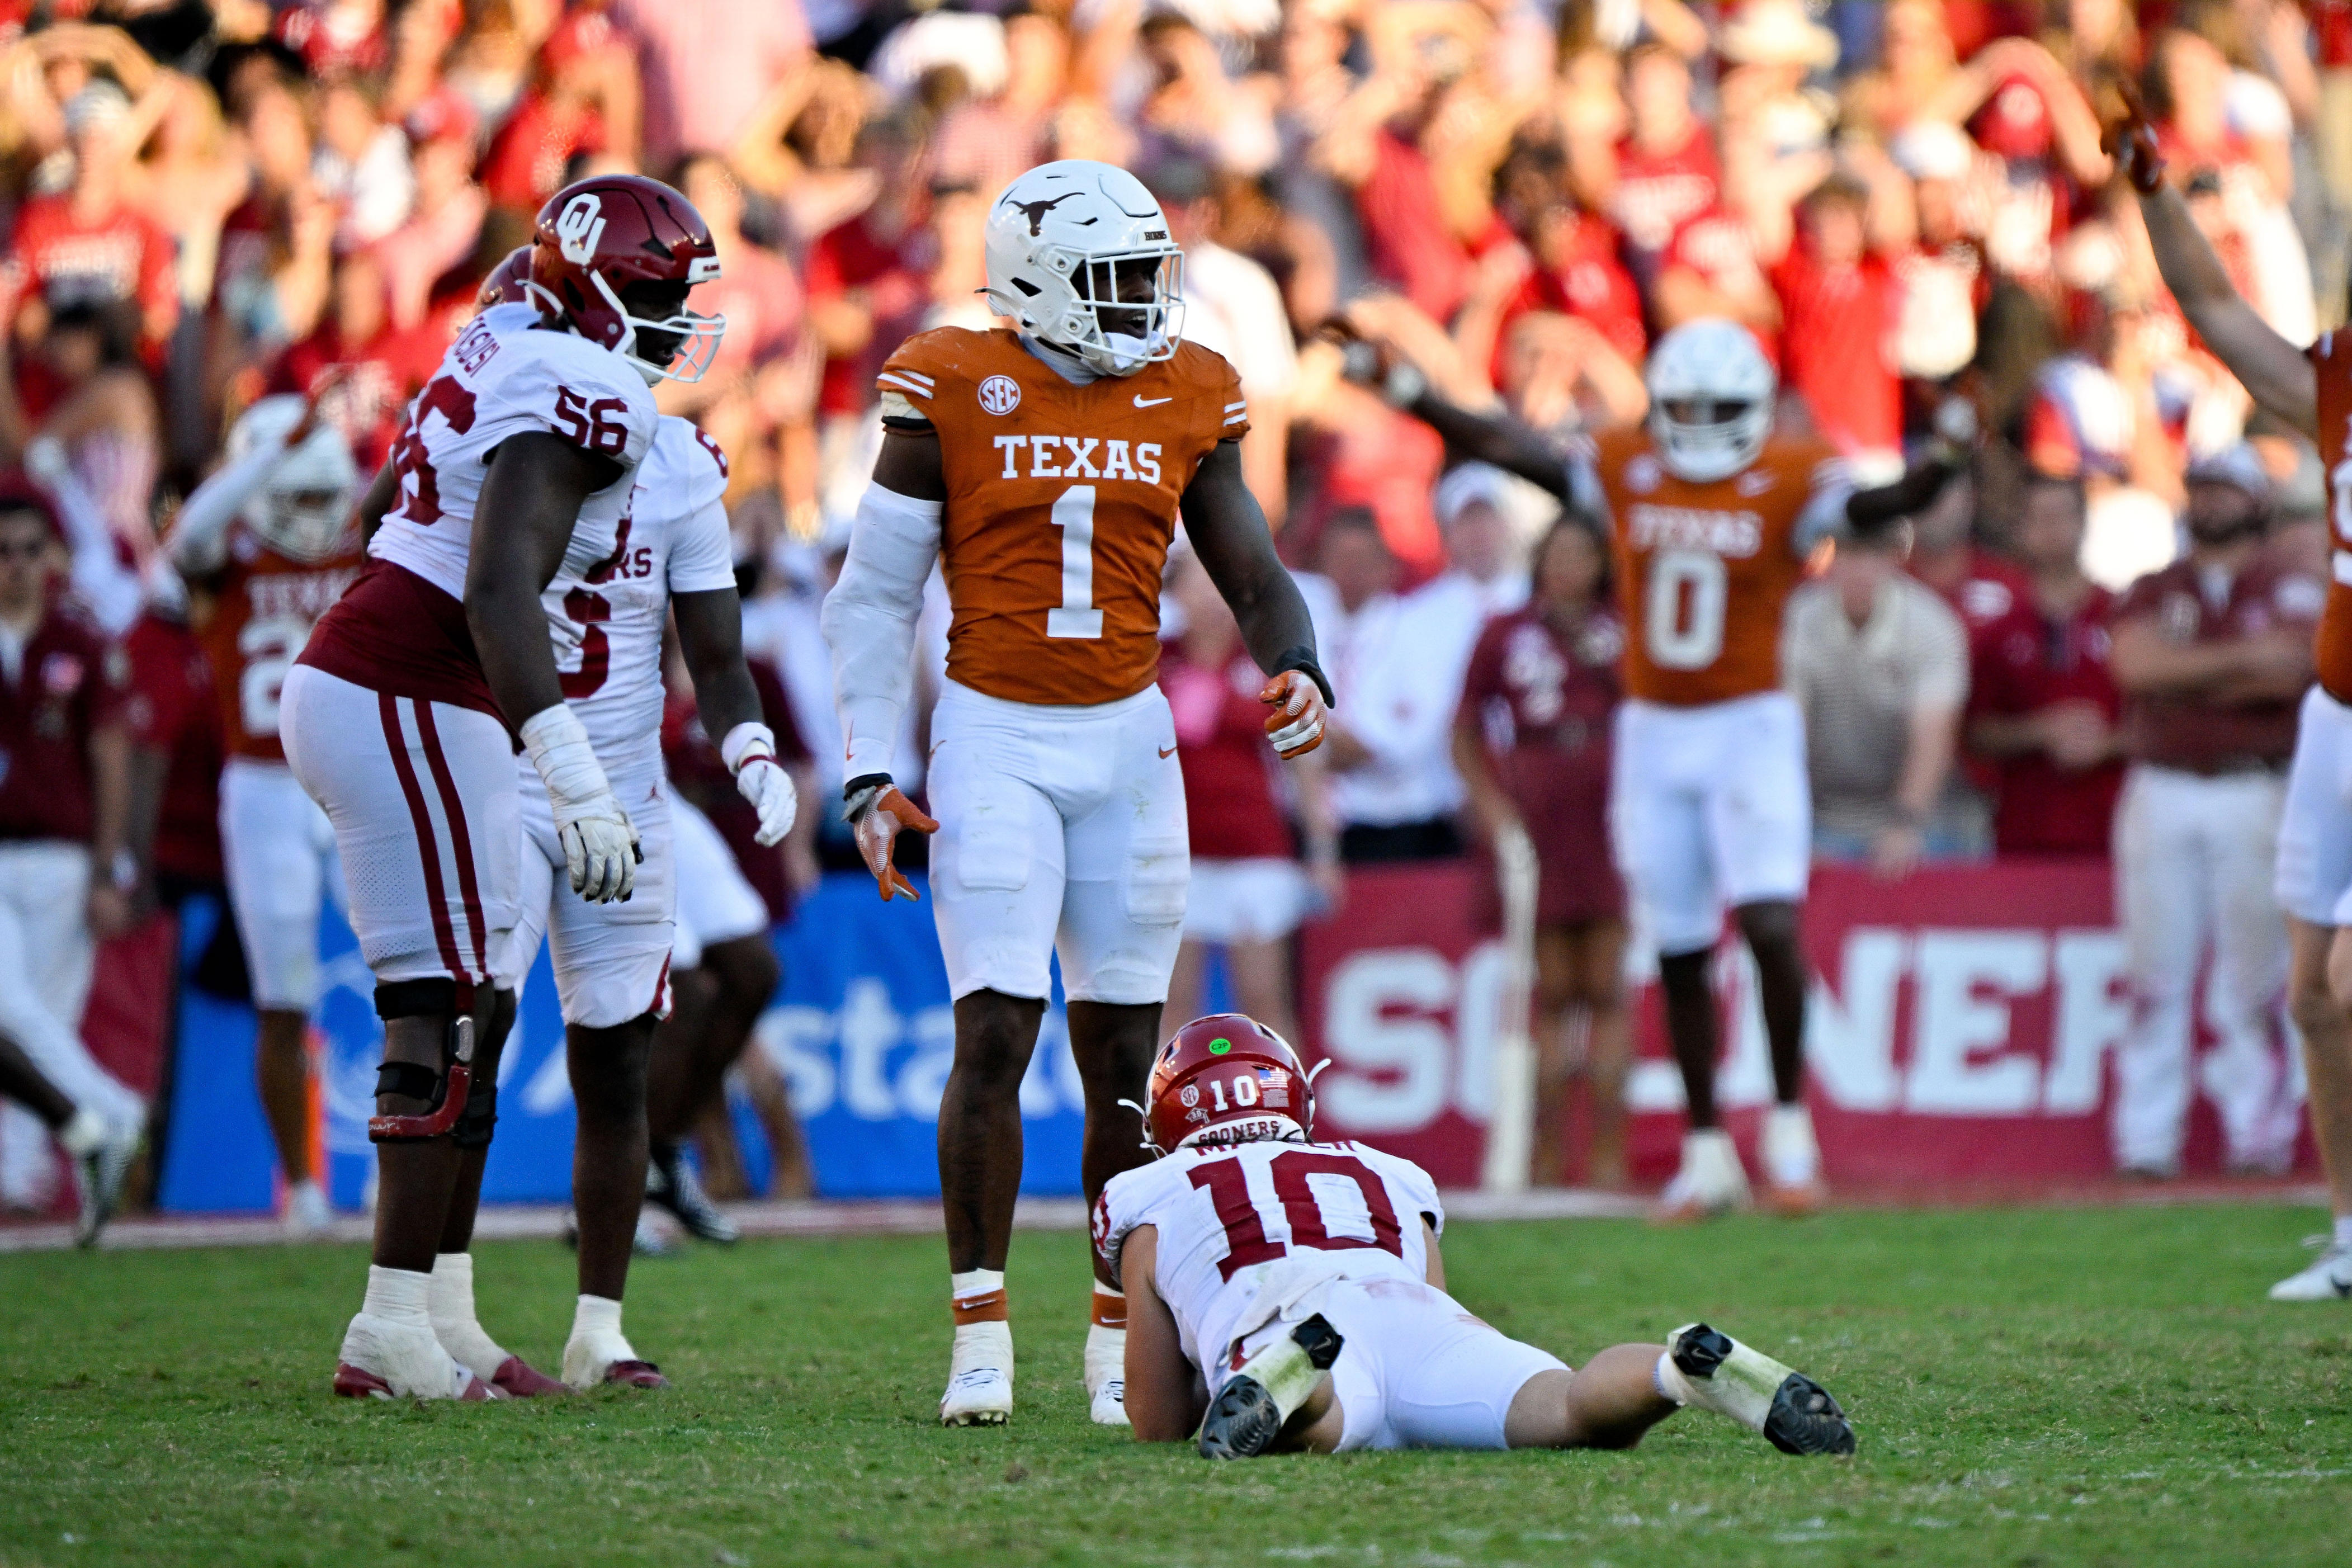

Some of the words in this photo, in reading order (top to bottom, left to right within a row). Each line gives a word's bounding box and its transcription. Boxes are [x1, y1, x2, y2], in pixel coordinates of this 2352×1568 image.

[551, 385, 629, 456] 56
[981, 378, 1018, 413] SEC
[994, 435, 1163, 485] TEXAS
[1047, 484, 1104, 639] 1
[1644, 549, 1729, 670] 0
[1211, 1042, 1229, 1050] C2P
[1211, 1075, 1258, 1112] 10
[1186, 1150, 1403, 1284] 10
